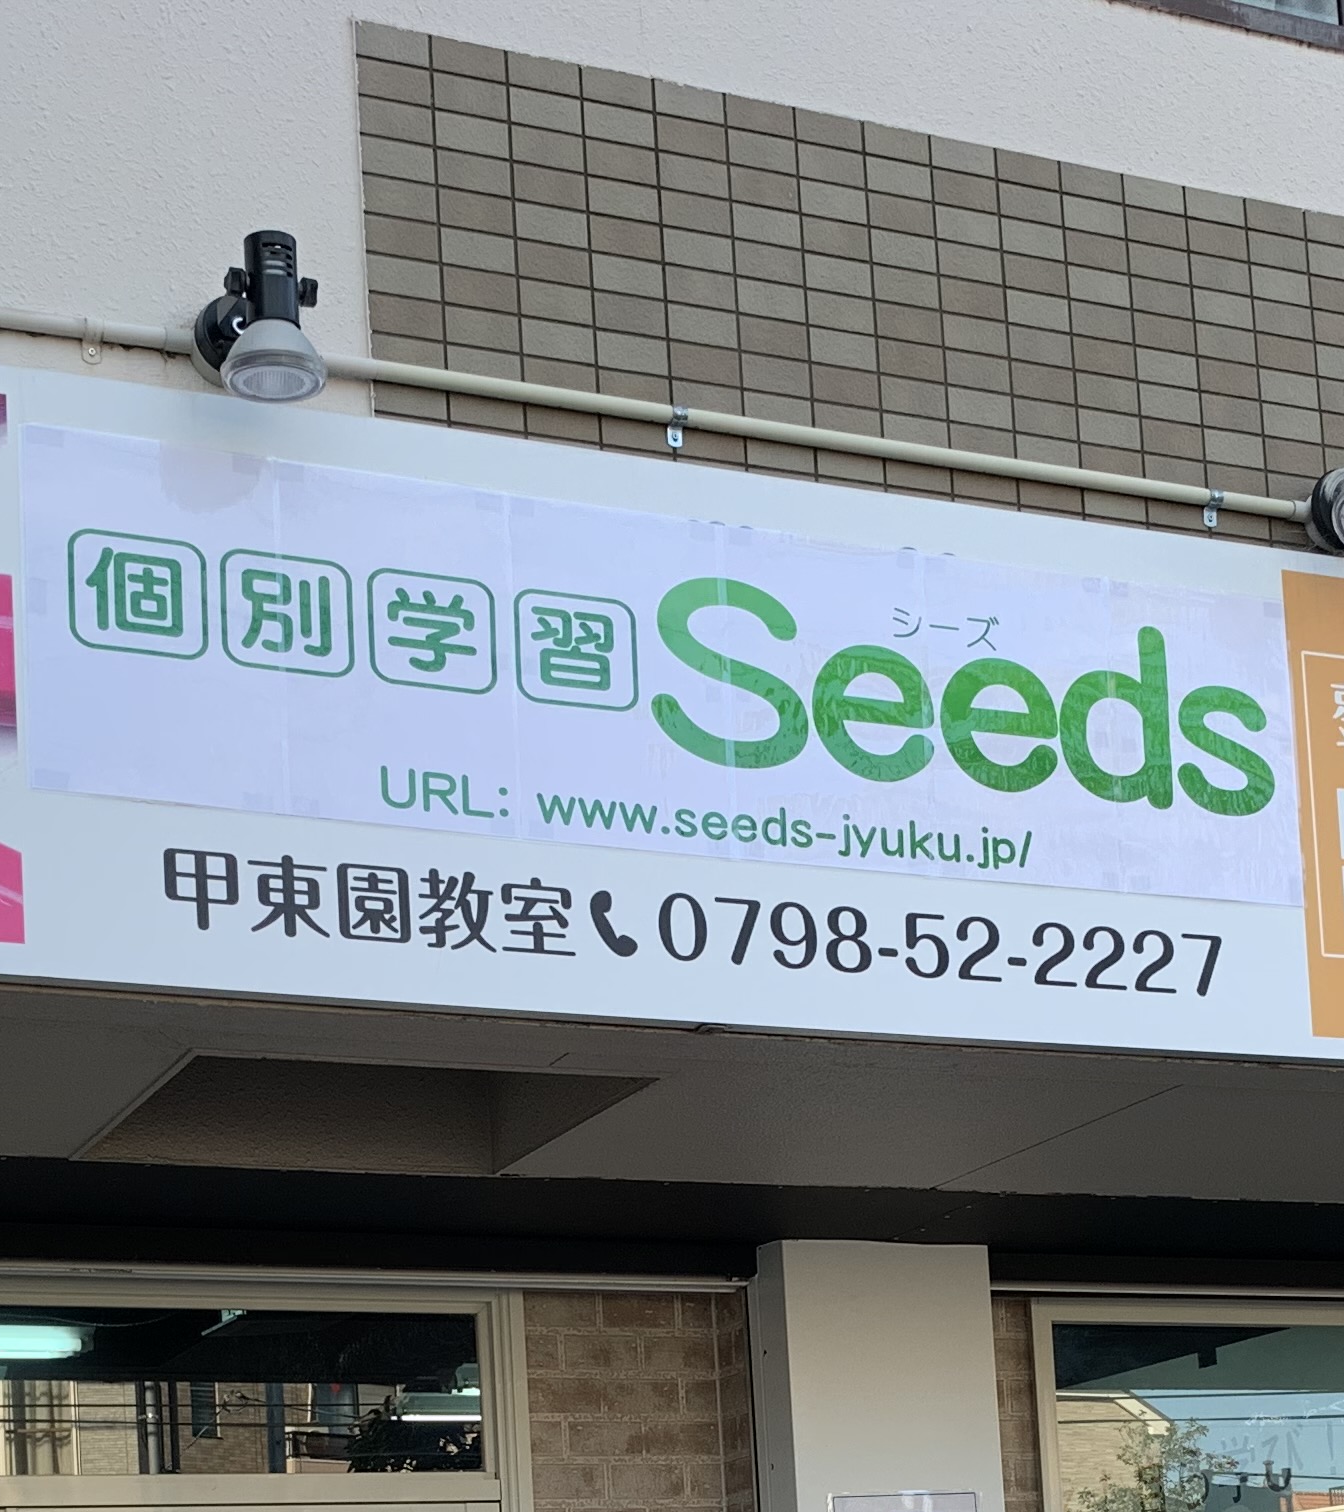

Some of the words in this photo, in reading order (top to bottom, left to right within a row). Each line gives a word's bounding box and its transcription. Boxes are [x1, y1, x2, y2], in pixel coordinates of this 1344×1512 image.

[85, 546, 615, 692] 個別学習
[891, 606, 1000, 652] シーズ
[652, 577, 1276, 816] Seeds
[536, 790, 1032, 870] www.seeds-jyuku.jp/
[164, 846, 576, 957] 甲東園教室
[658, 891, 1223, 998] 0798-52-2227
